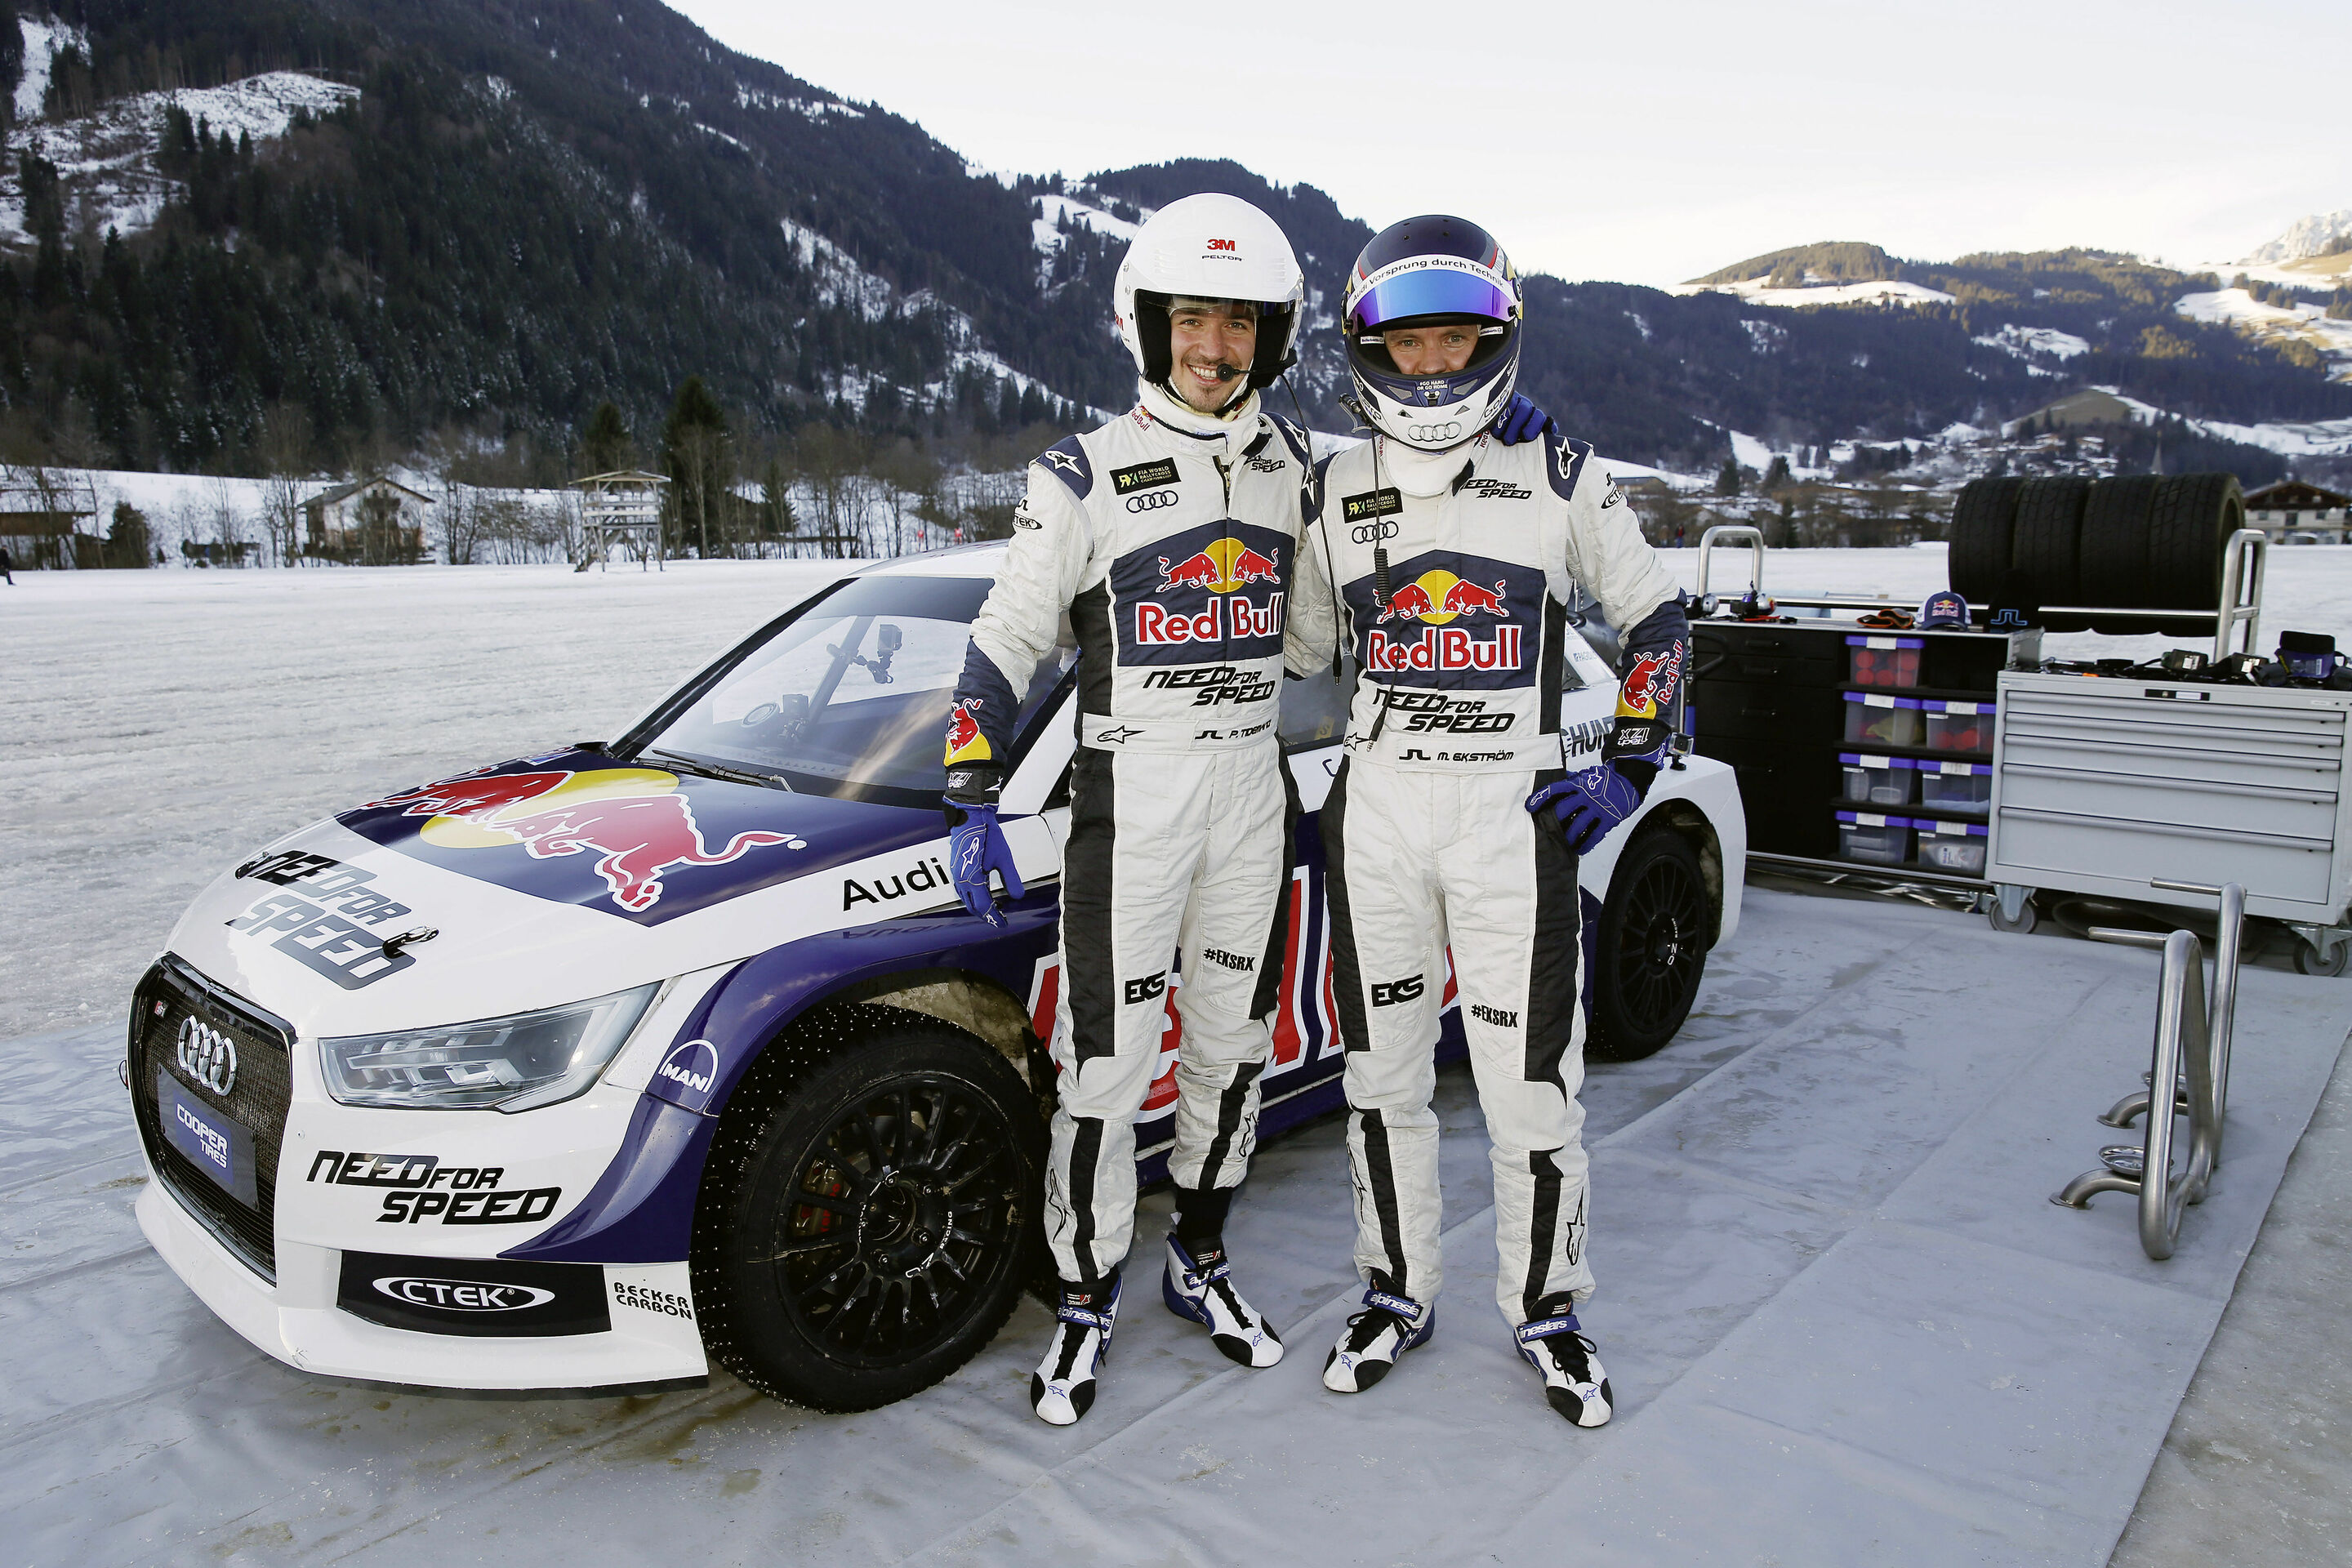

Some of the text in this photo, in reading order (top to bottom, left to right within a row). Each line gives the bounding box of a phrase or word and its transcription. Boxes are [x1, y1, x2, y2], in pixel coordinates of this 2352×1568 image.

[1207, 238, 1236, 252] 3M
[1352, 259, 1504, 303] Audi Vorsprung durch Technik
[1148, 466, 1169, 474] WORLD
[1250, 460, 1285, 473] SPEED
[1477, 489, 1532, 500] SPEED
[1137, 593, 1283, 644] Red Bull
[1368, 626, 1521, 670] Red Bull
[1143, 666, 1263, 688] NEED FOR
[1656, 639, 1684, 705] Red Bull
[1189, 680, 1275, 706] SPEED
[1440, 701, 1486, 714] FOR
[1402, 713, 1516, 733] SPEED
[1437, 750, 1514, 763] M. EKSTRÖM
[844, 858, 950, 911] Audi
[318, 885, 412, 925] FOR
[224, 894, 416, 991] SPEED
[1204, 947, 1256, 972] #EKSRX
[1125, 969, 1166, 1005] EKS
[1370, 973, 1425, 1008] EKS
[1471, 1004, 1519, 1029] #EKSRX
[662, 1063, 709, 1092] MAN
[176, 1102, 228, 1156] COOPER
[199, 1138, 228, 1169] TIRES
[306, 1150, 505, 1189] NEED FOR
[375, 1187, 563, 1225] SPEED
[613, 1281, 689, 1309] BECKER
[616, 1294, 693, 1321] CARBON
